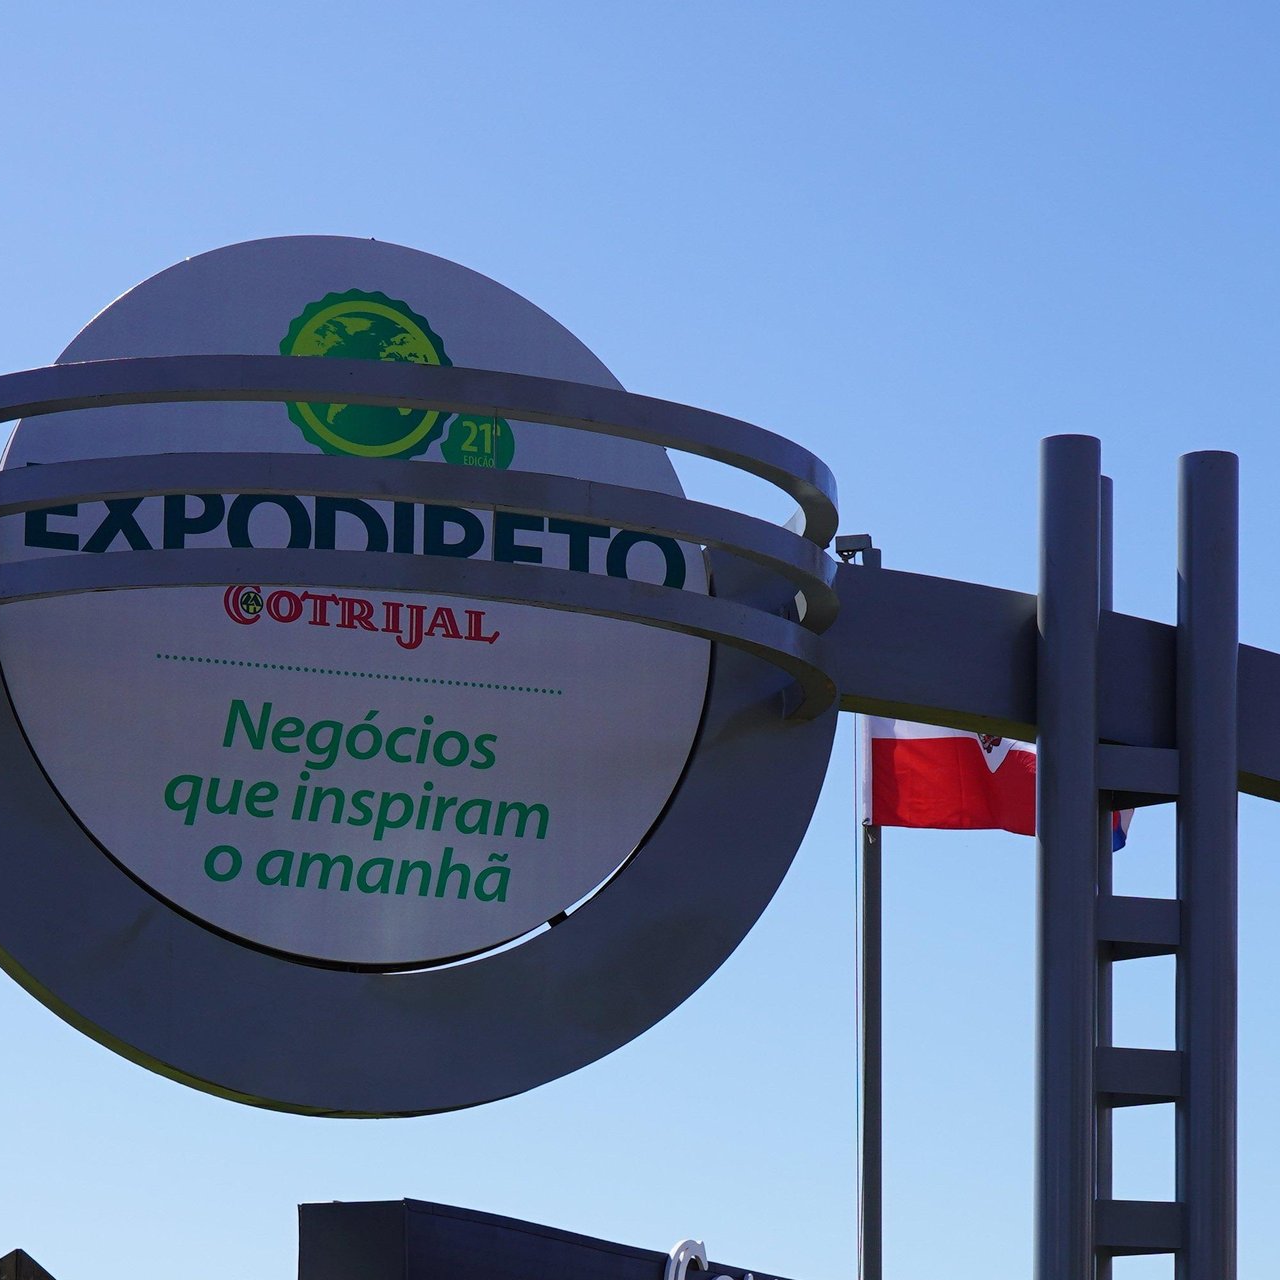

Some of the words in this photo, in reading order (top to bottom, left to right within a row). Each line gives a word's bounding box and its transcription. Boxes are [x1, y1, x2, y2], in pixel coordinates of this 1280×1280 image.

[224, 585, 500, 650] COTRIJAL
[223, 700, 498, 770] Negócios
[163, 772, 279, 824] que
[291, 770, 550, 841] inspiram
[203, 845, 243, 882] o
[256, 846, 512, 904] amanhã
